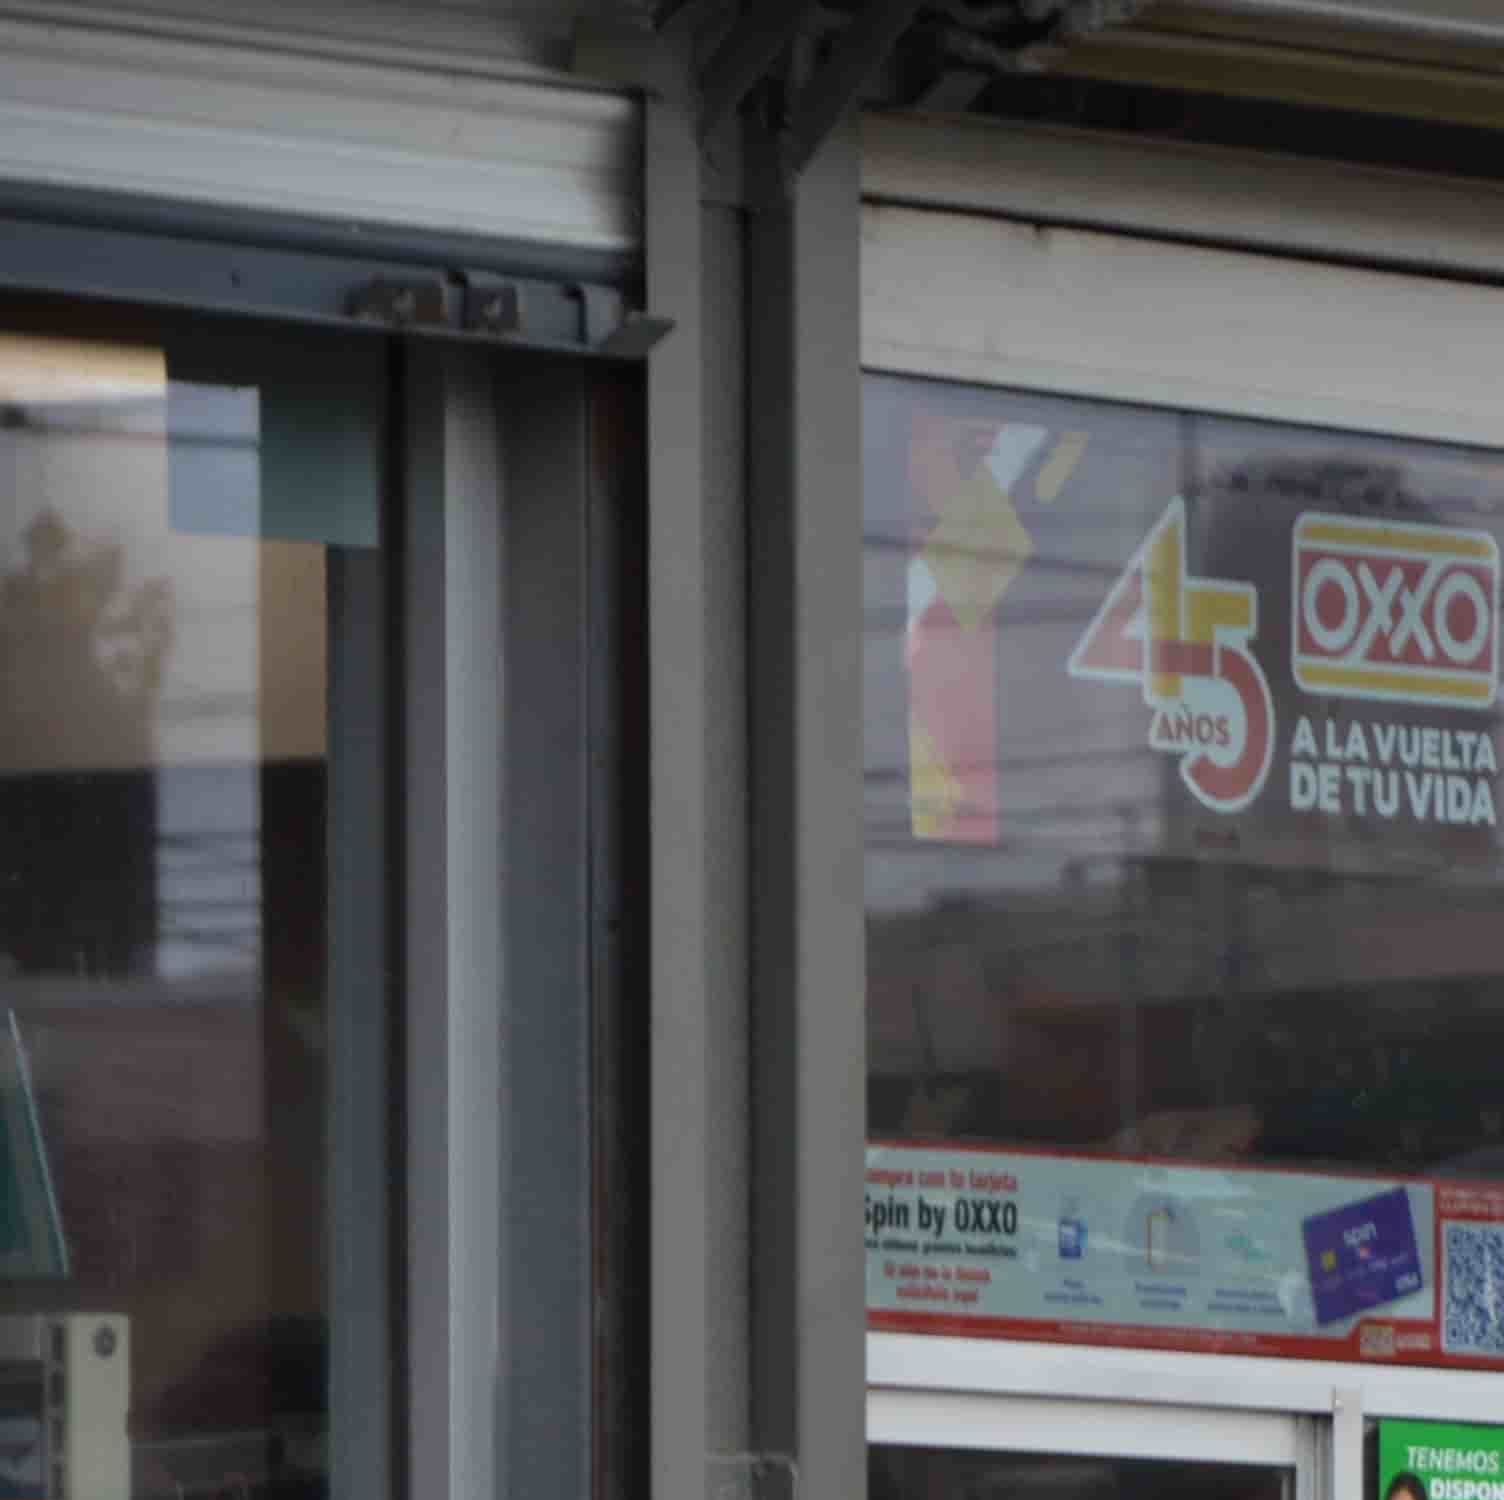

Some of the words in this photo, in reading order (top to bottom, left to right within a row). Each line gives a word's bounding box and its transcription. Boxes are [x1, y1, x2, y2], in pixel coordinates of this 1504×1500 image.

[1302, 558, 1492, 665] OXXO
[1154, 703, 1231, 747] AÑOS
[1291, 717, 1316, 758] A
[1325, 721, 1370, 763] LA
[1373, 724, 1497, 775] VUELTA
[1290, 762, 1342, 813] DE
[1347, 768, 1401, 818] TU
[1400, 773, 1497, 825] VIDA
[918, 1195, 946, 1239] by
[1407, 1445, 1498, 1474] TENEMOS
